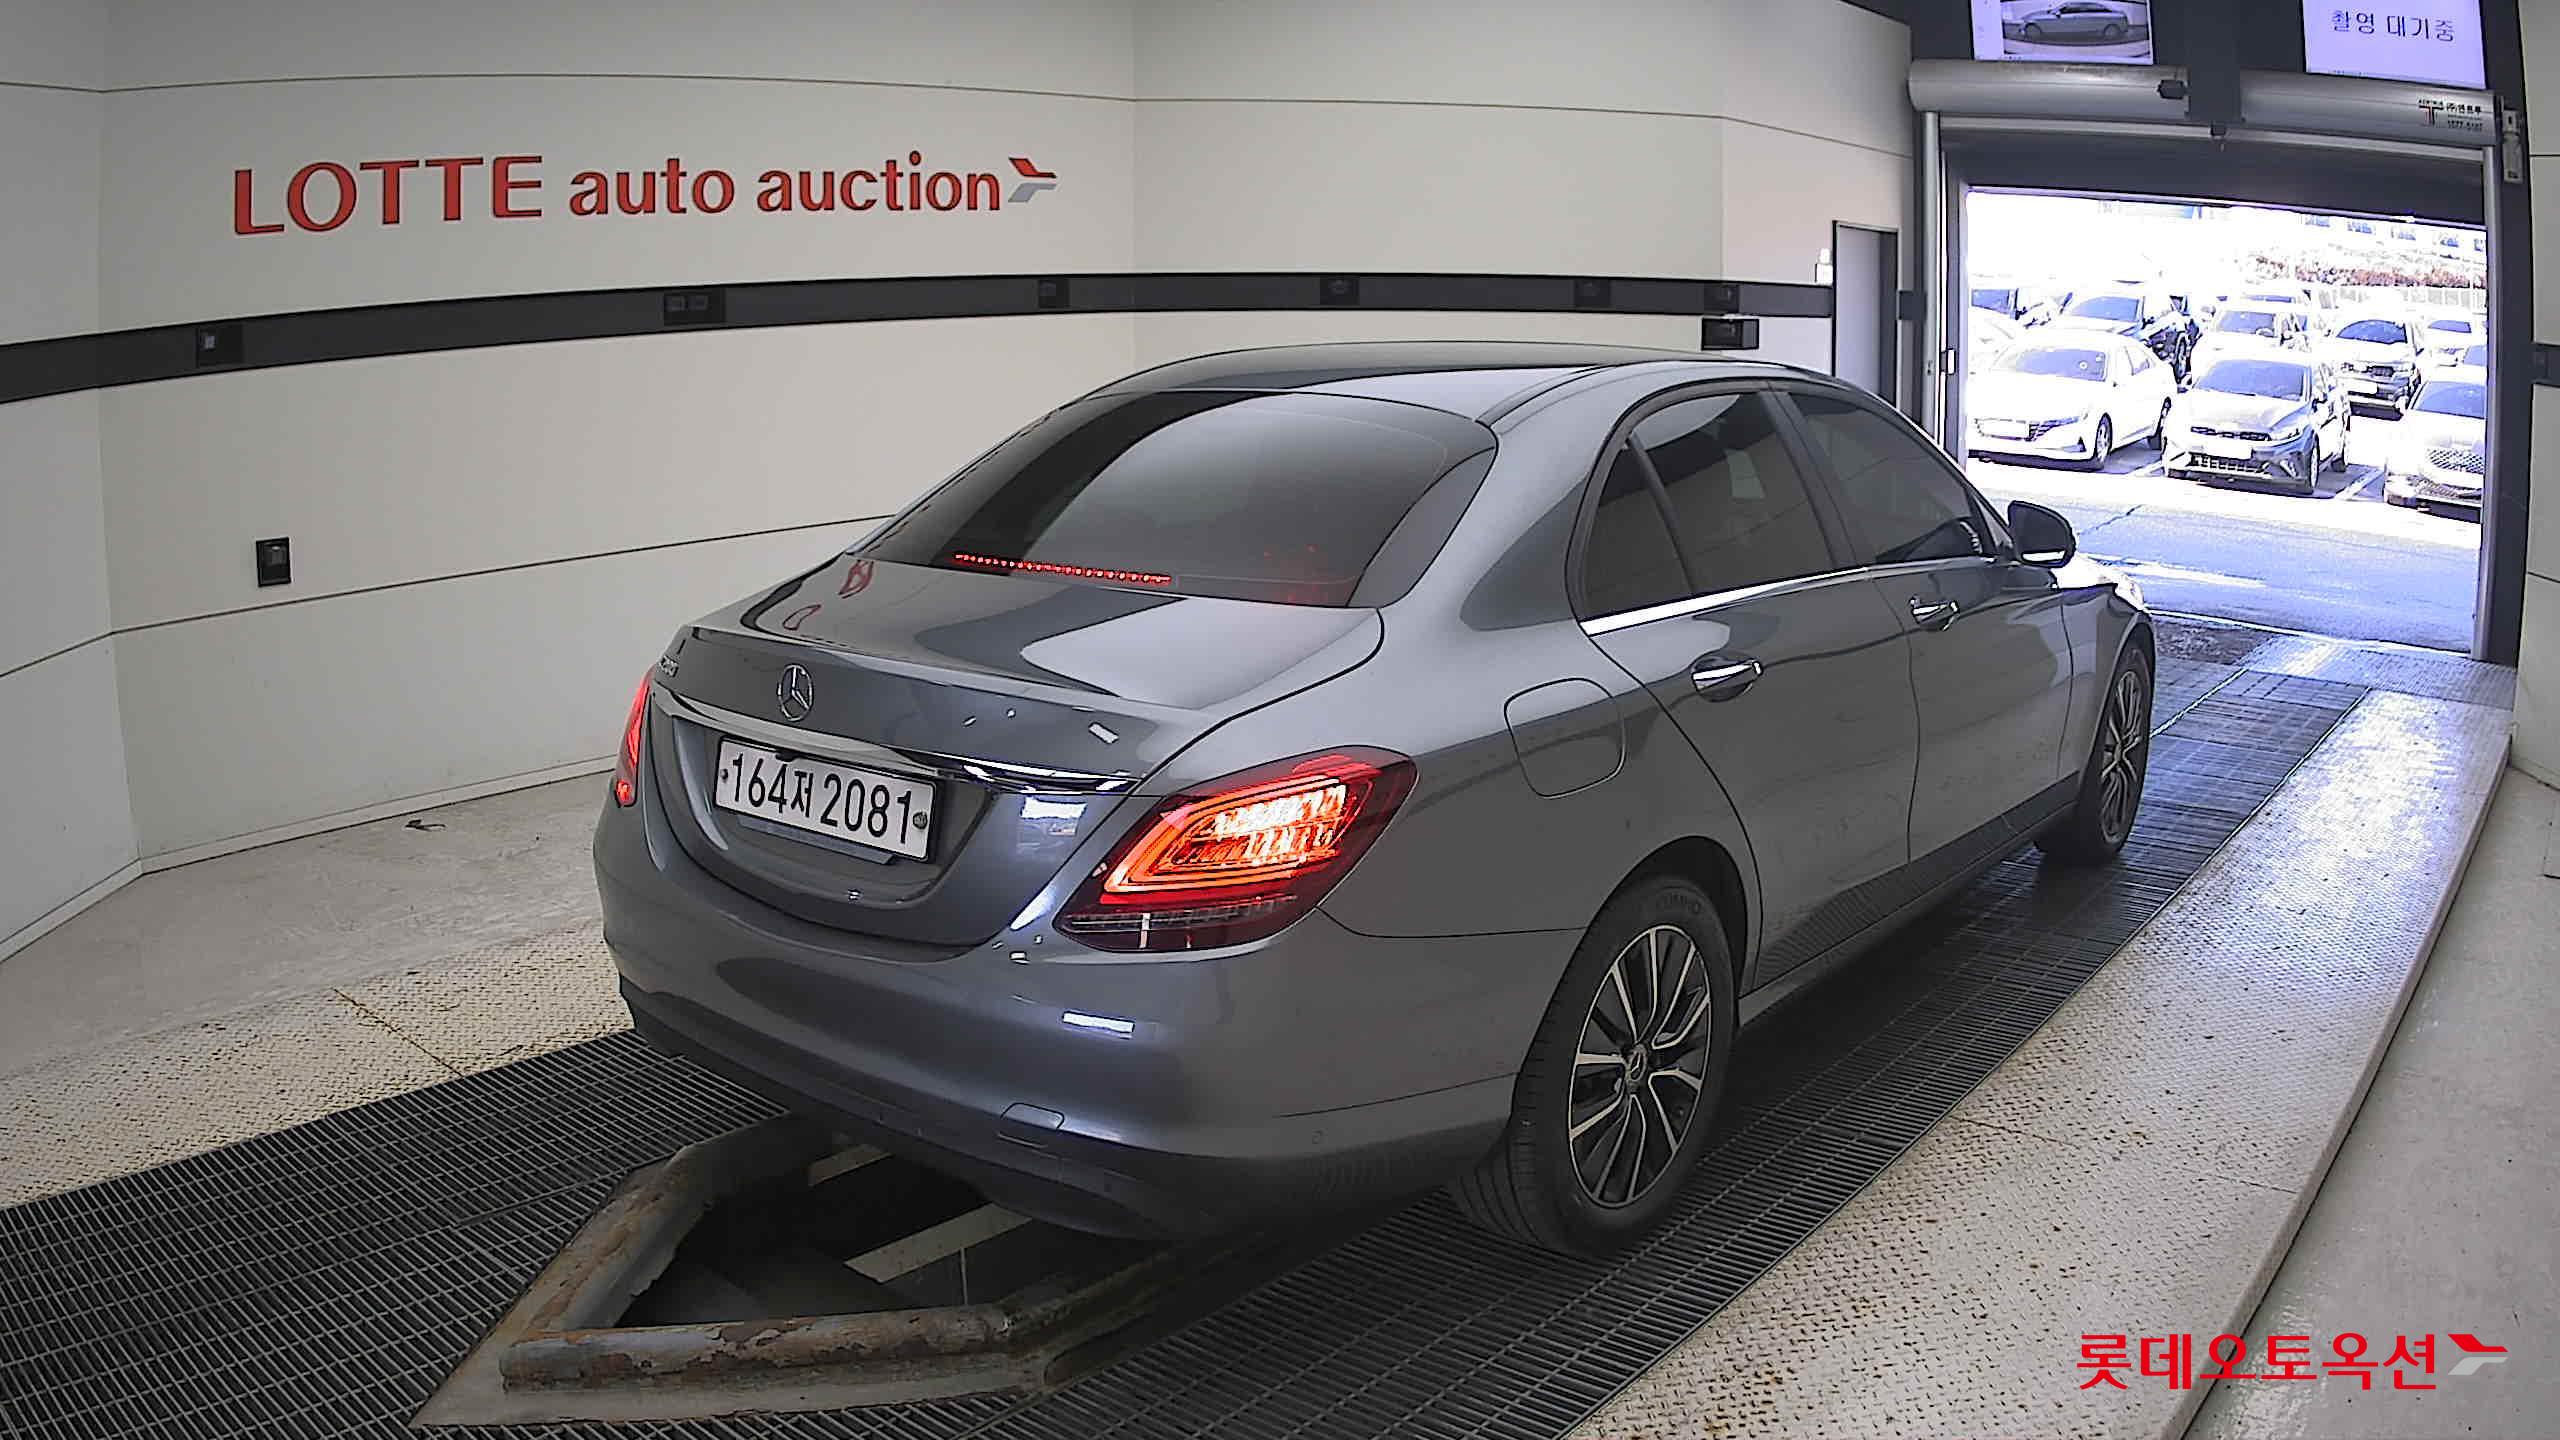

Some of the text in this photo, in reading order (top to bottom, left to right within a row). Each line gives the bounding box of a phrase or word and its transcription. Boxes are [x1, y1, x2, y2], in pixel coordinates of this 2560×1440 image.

[2332, 10, 2374, 34] 촬영
[234, 151, 1001, 234] LOTTE auto auction
[820, 773, 912, 844] 2081
